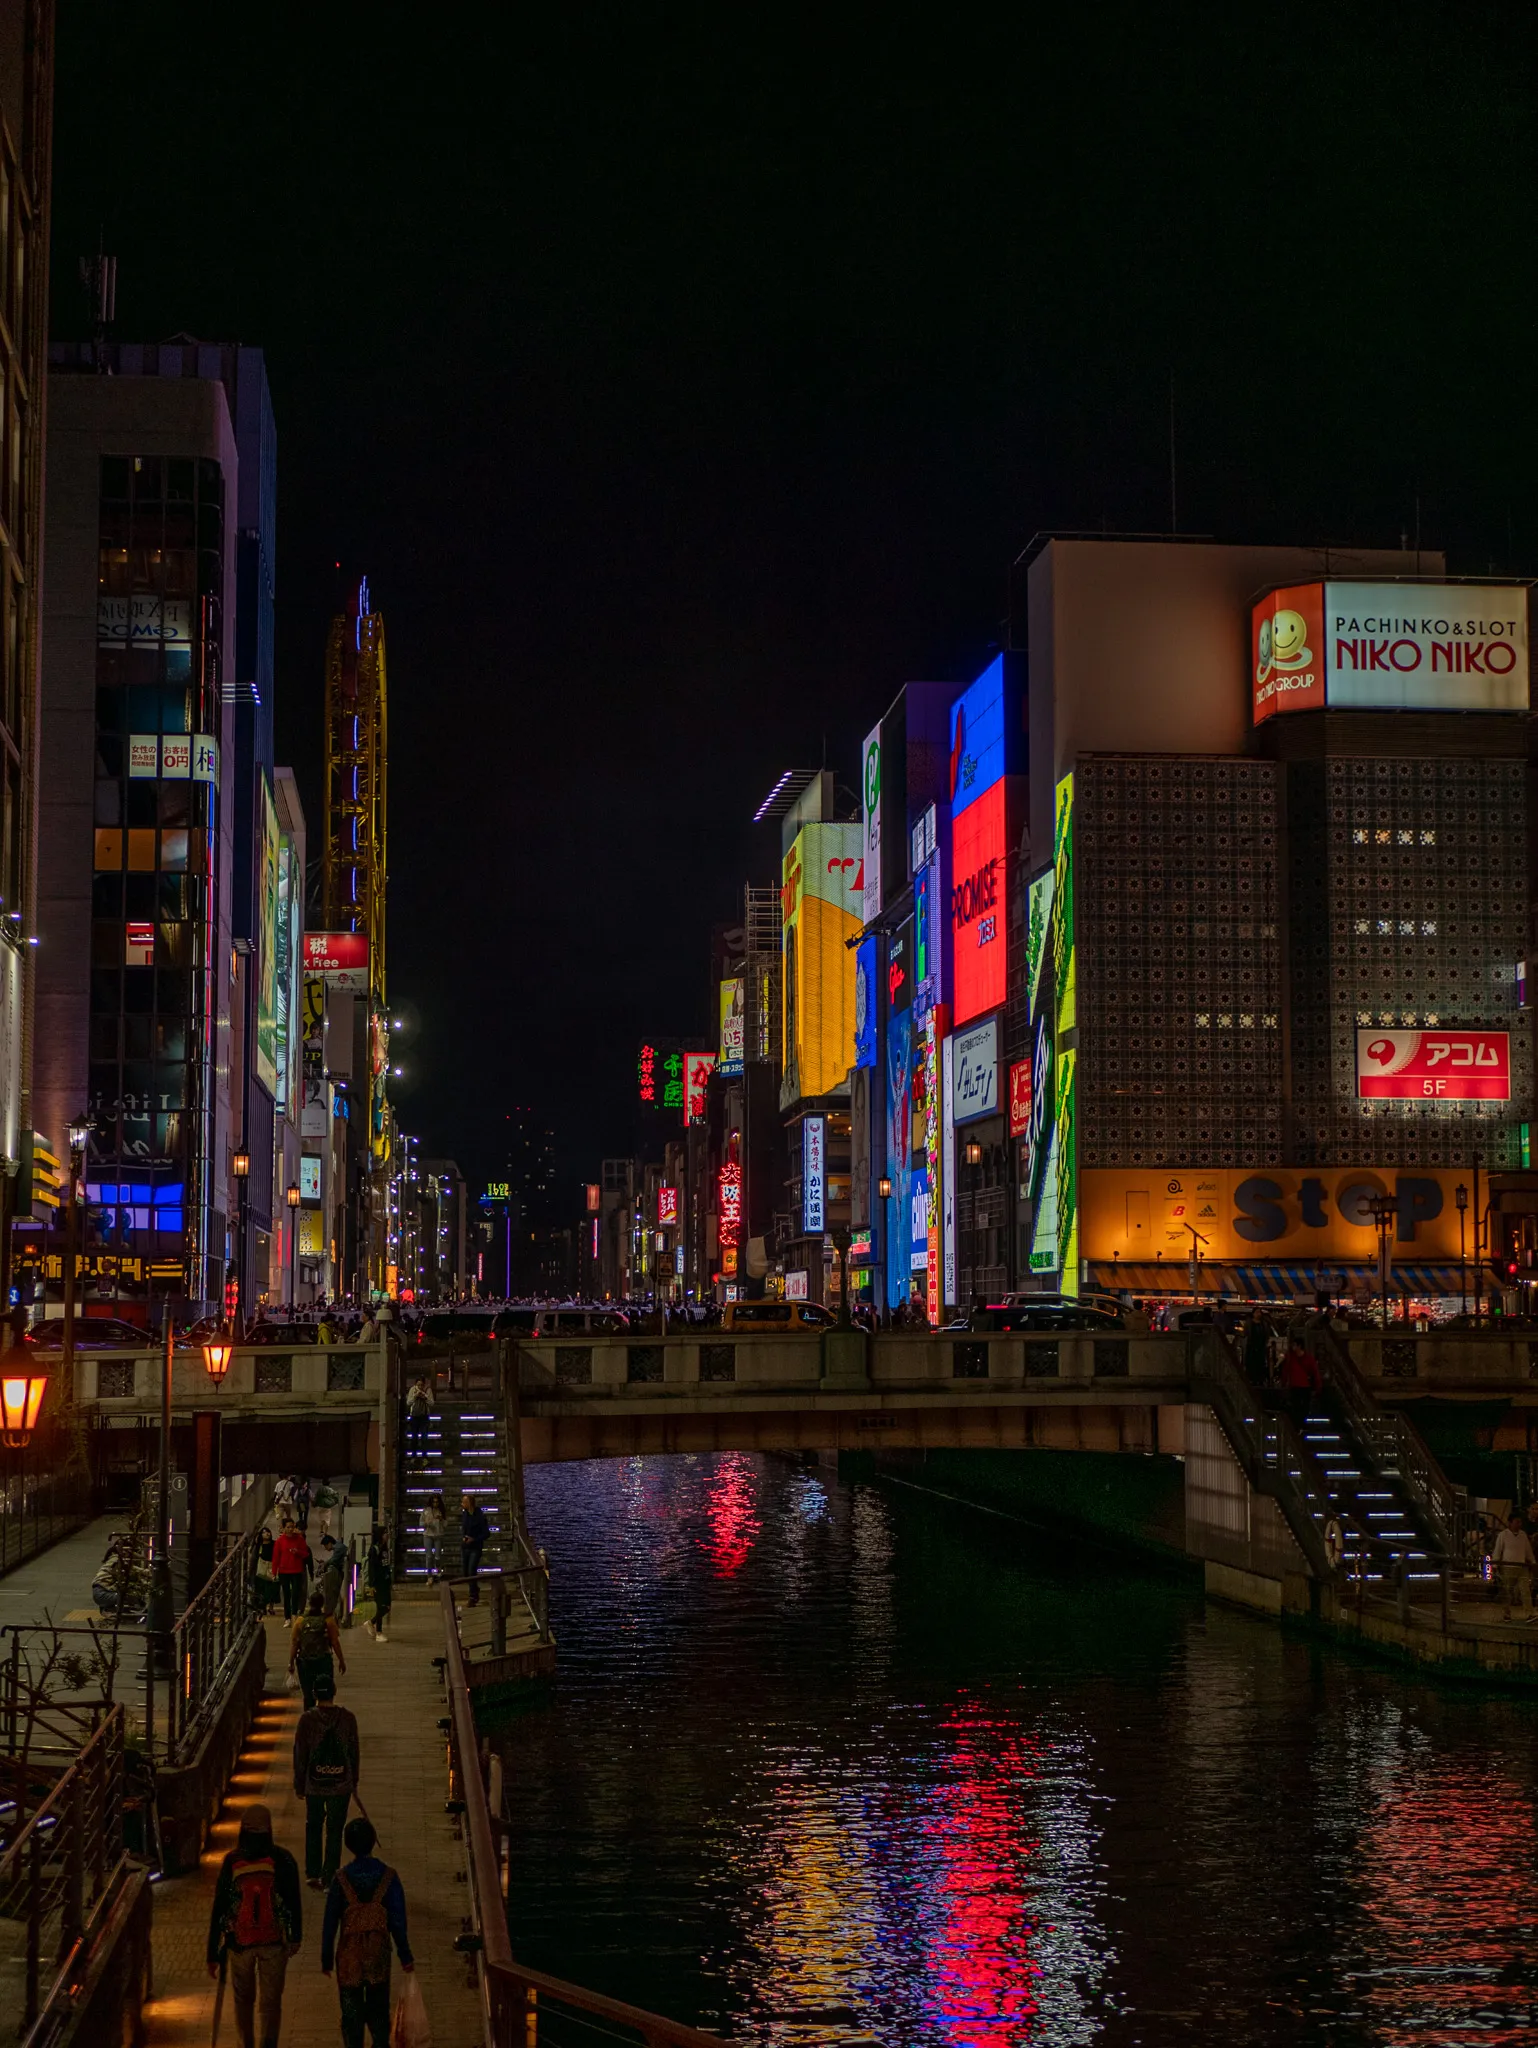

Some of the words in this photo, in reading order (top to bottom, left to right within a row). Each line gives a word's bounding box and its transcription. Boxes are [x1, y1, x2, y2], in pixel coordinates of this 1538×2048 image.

[1336, 618, 1516, 640] PACHINKO&SLOT
[1336, 639, 1422, 672] NIKO
[1432, 642, 1517, 674] NIKO
[1275, 674, 1314, 691] GROUP
[164, 746, 188, 754] お客様
[164, 755, 189, 768] 0円
[952, 858, 997, 933] PROMISE
[310, 937, 328, 955] 税
[313, 957, 340, 968] Free
[1426, 1043, 1499, 1066] アコム
[640, 1045, 655, 1101] お好み焼
[1423, 1080, 1446, 1095] 5F
[811, 1135, 821, 1173] 本場の味
[660, 1192, 668, 1215] ドラッグ
[667, 1189, 675, 1210] ツルハ
